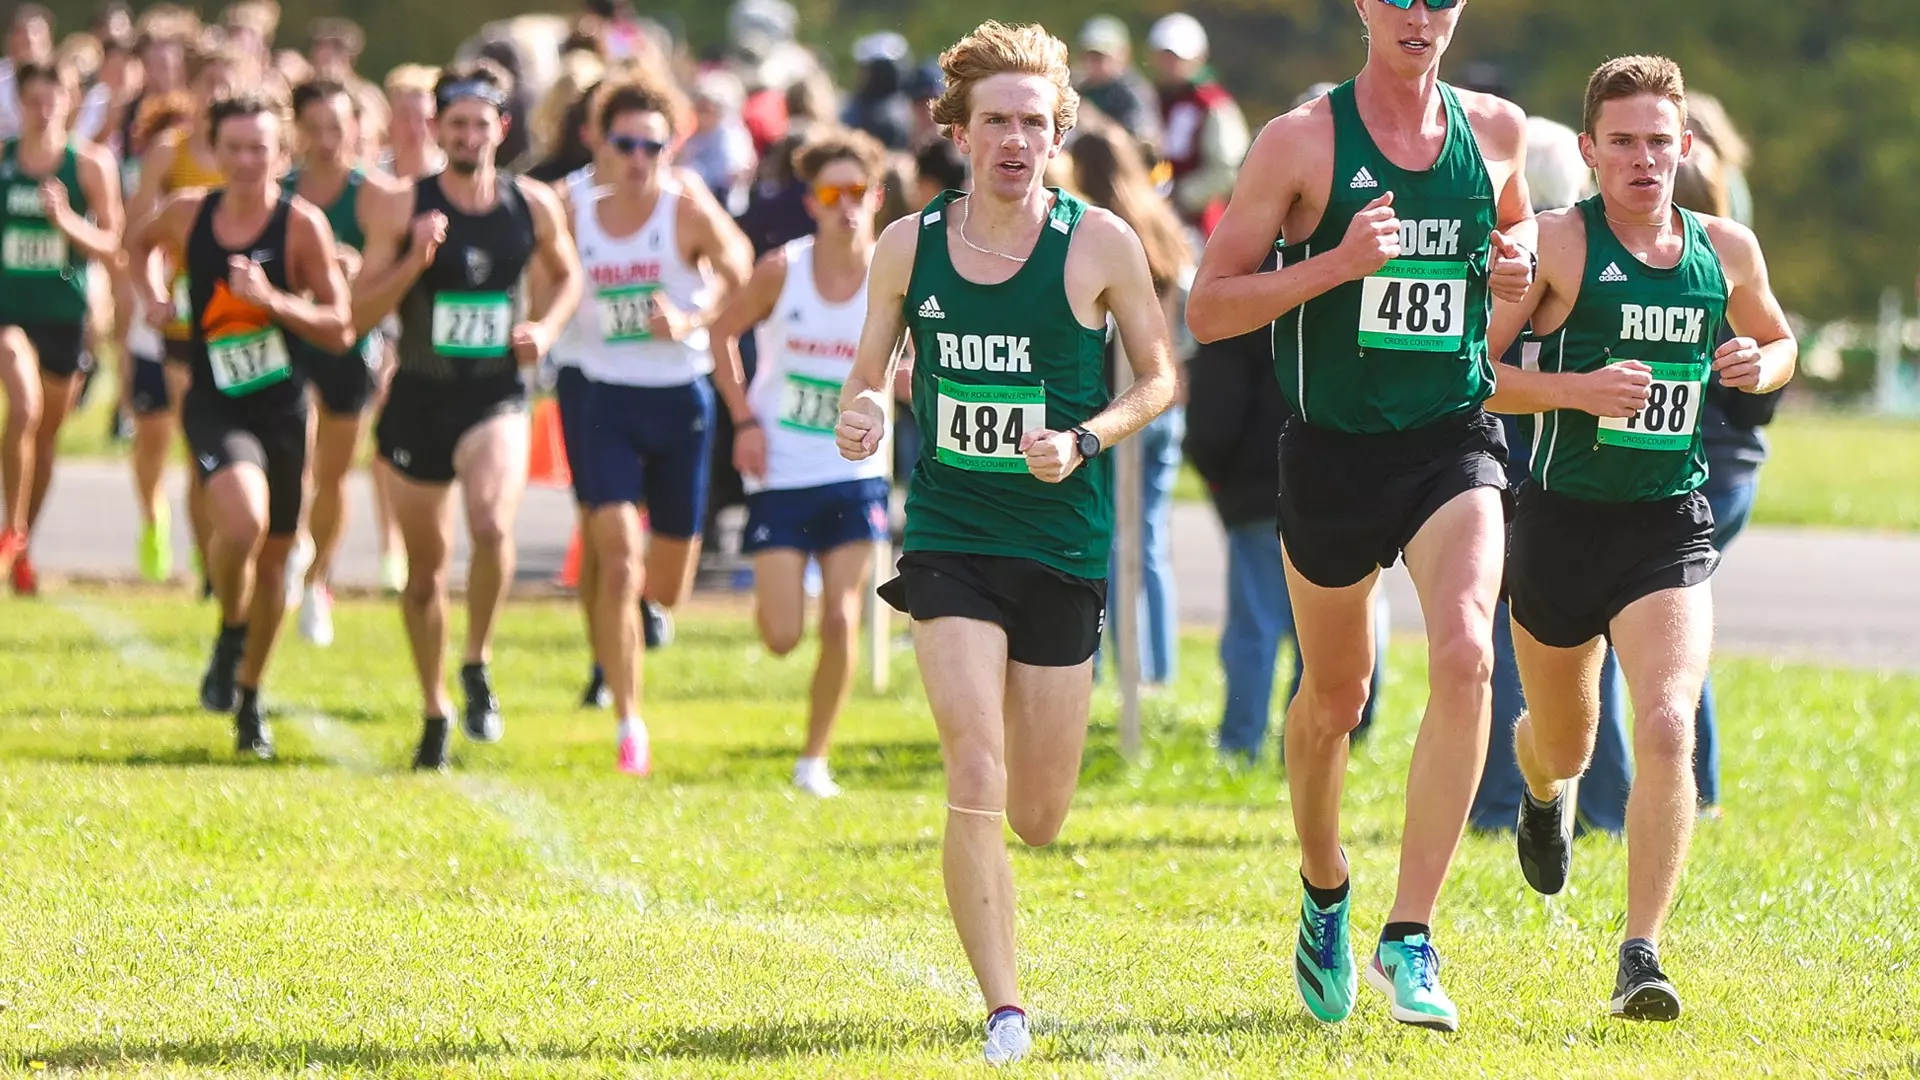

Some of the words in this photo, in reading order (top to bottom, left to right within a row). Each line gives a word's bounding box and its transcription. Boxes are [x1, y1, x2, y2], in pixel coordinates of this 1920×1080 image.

[1350, 179, 1378, 188] adidas
[1400, 219, 1461, 256] OCK
[1377, 265, 1404, 275] LIPPERY
[1407, 267, 1426, 275] ROCK
[1427, 268, 1461, 276] UNIVERSITY
[1599, 274, 1628, 282] adidas
[1377, 282, 1452, 333] 483
[918, 310, 945, 319] adidas
[1620, 304, 1704, 343] ROCK
[1384, 336, 1408, 346] CROSS
[1410, 338, 1445, 347] COUNTRY
[937, 332, 1031, 372] ROCK
[944, 384, 969, 399] SLIPPERY
[971, 391, 992, 399] ROCK
[993, 391, 1038, 400] UNIVERSITY
[950, 404, 1023, 456] 484
[1622, 435, 1645, 445] CROSS
[1647, 436, 1677, 446] COUNTRY
[956, 457, 980, 467] CROSS
[981, 459, 1019, 469] COUNTRY
